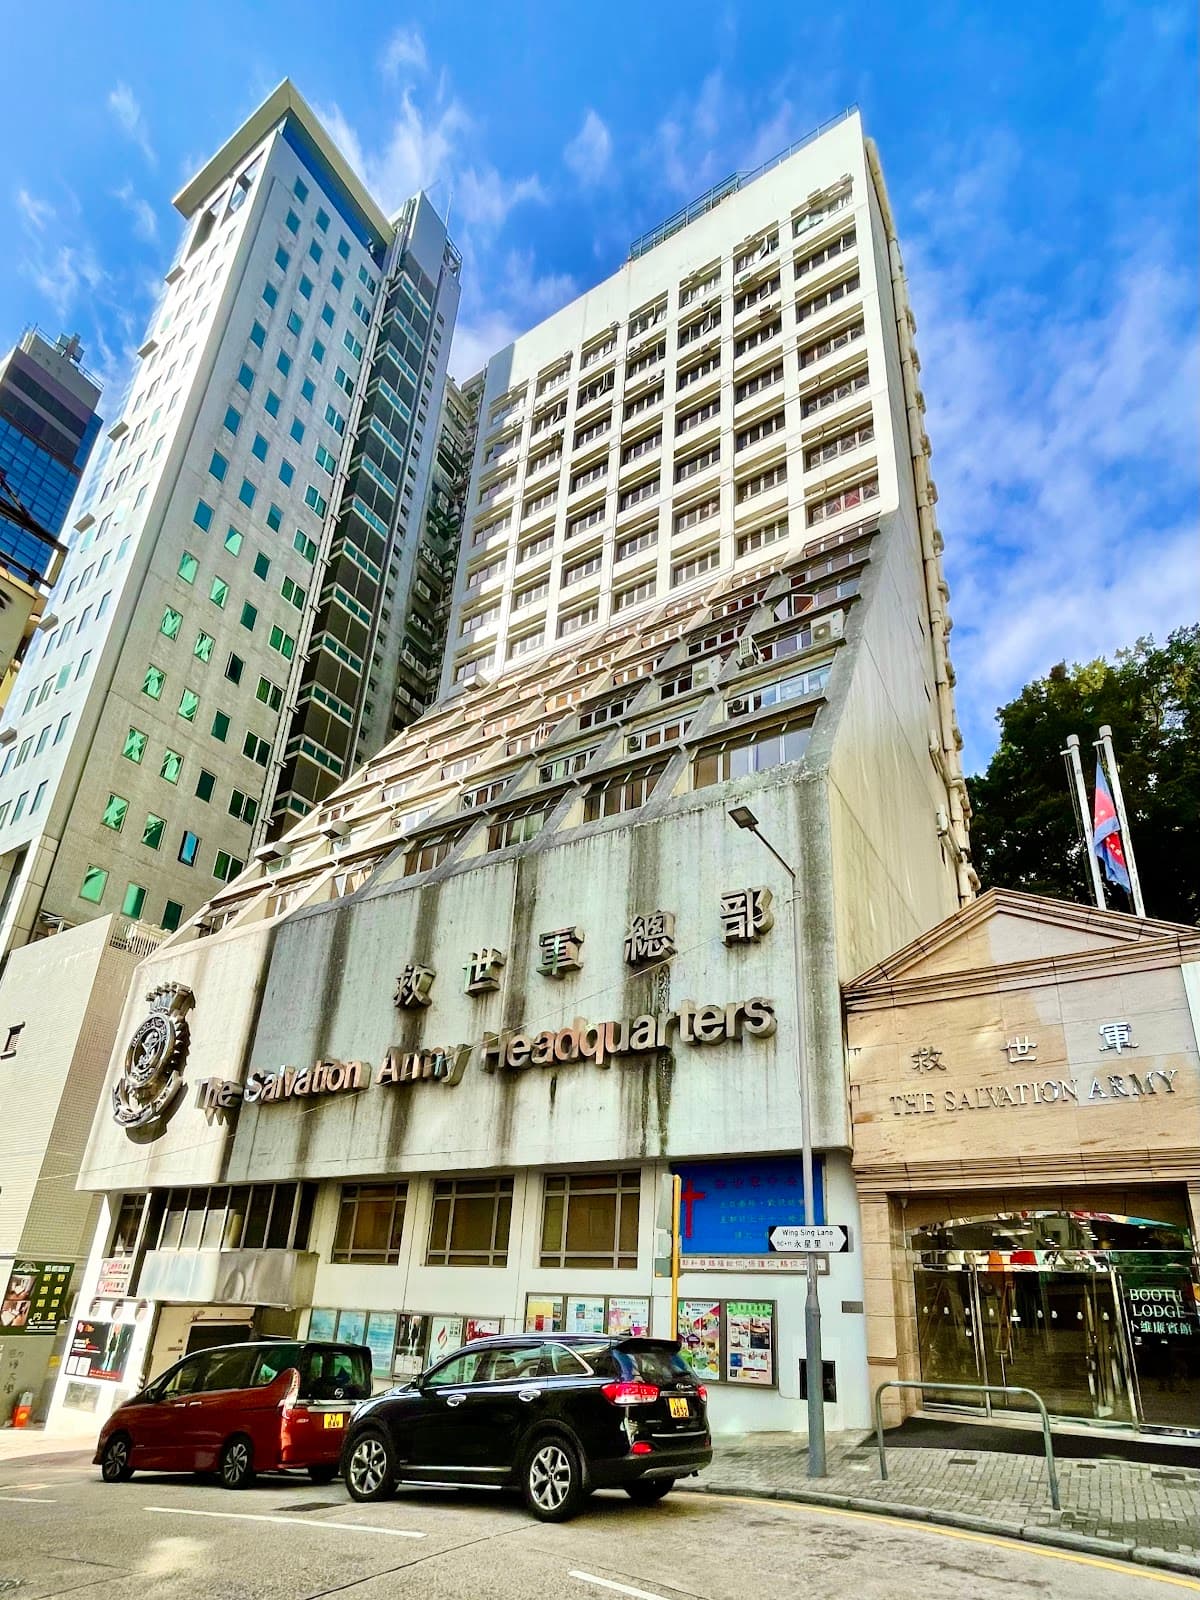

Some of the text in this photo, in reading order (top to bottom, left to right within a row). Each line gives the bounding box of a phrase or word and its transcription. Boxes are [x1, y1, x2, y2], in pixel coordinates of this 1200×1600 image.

[394, 886, 774, 1009] 救世軍總部
[195, 996, 778, 1108] The Salvation Army Headquarters
[910, 1021, 1139, 1074] 救世軍
[889, 1069, 1178, 1115] THE SALVATION ARMY
[782, 1229, 799, 1237] Wing
[800, 1229, 815, 1237] Sing
[794, 1239, 822, 1248] 永星里
[1129, 1288, 1184, 1302] BOOTH
[1132, 1304, 1186, 1318] LODGE
